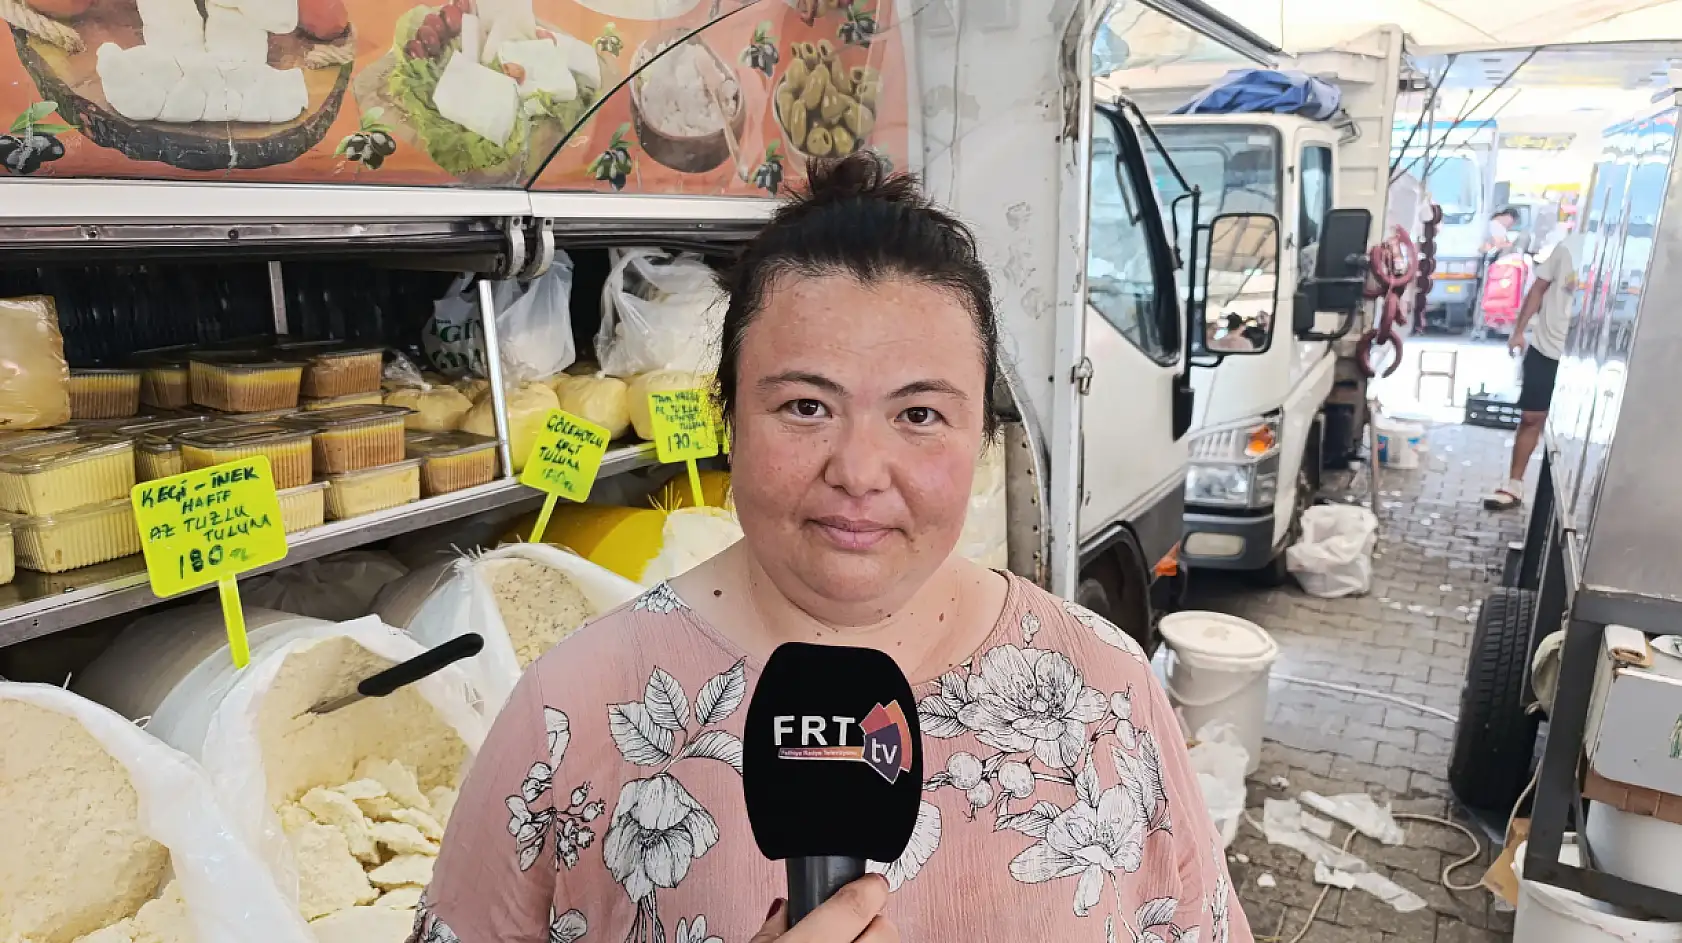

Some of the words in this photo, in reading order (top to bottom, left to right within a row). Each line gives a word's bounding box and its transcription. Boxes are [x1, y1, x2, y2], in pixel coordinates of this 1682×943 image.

[668, 432, 690, 453] 170
[209, 466, 260, 489] İNEK
[182, 490, 231, 515] HAFİF
[183, 505, 251, 533] TUZLU
[203, 513, 272, 542] TULUM
[179, 544, 224, 580] 180
[773, 715, 856, 746] FRT
[871, 738, 898, 764] tv
